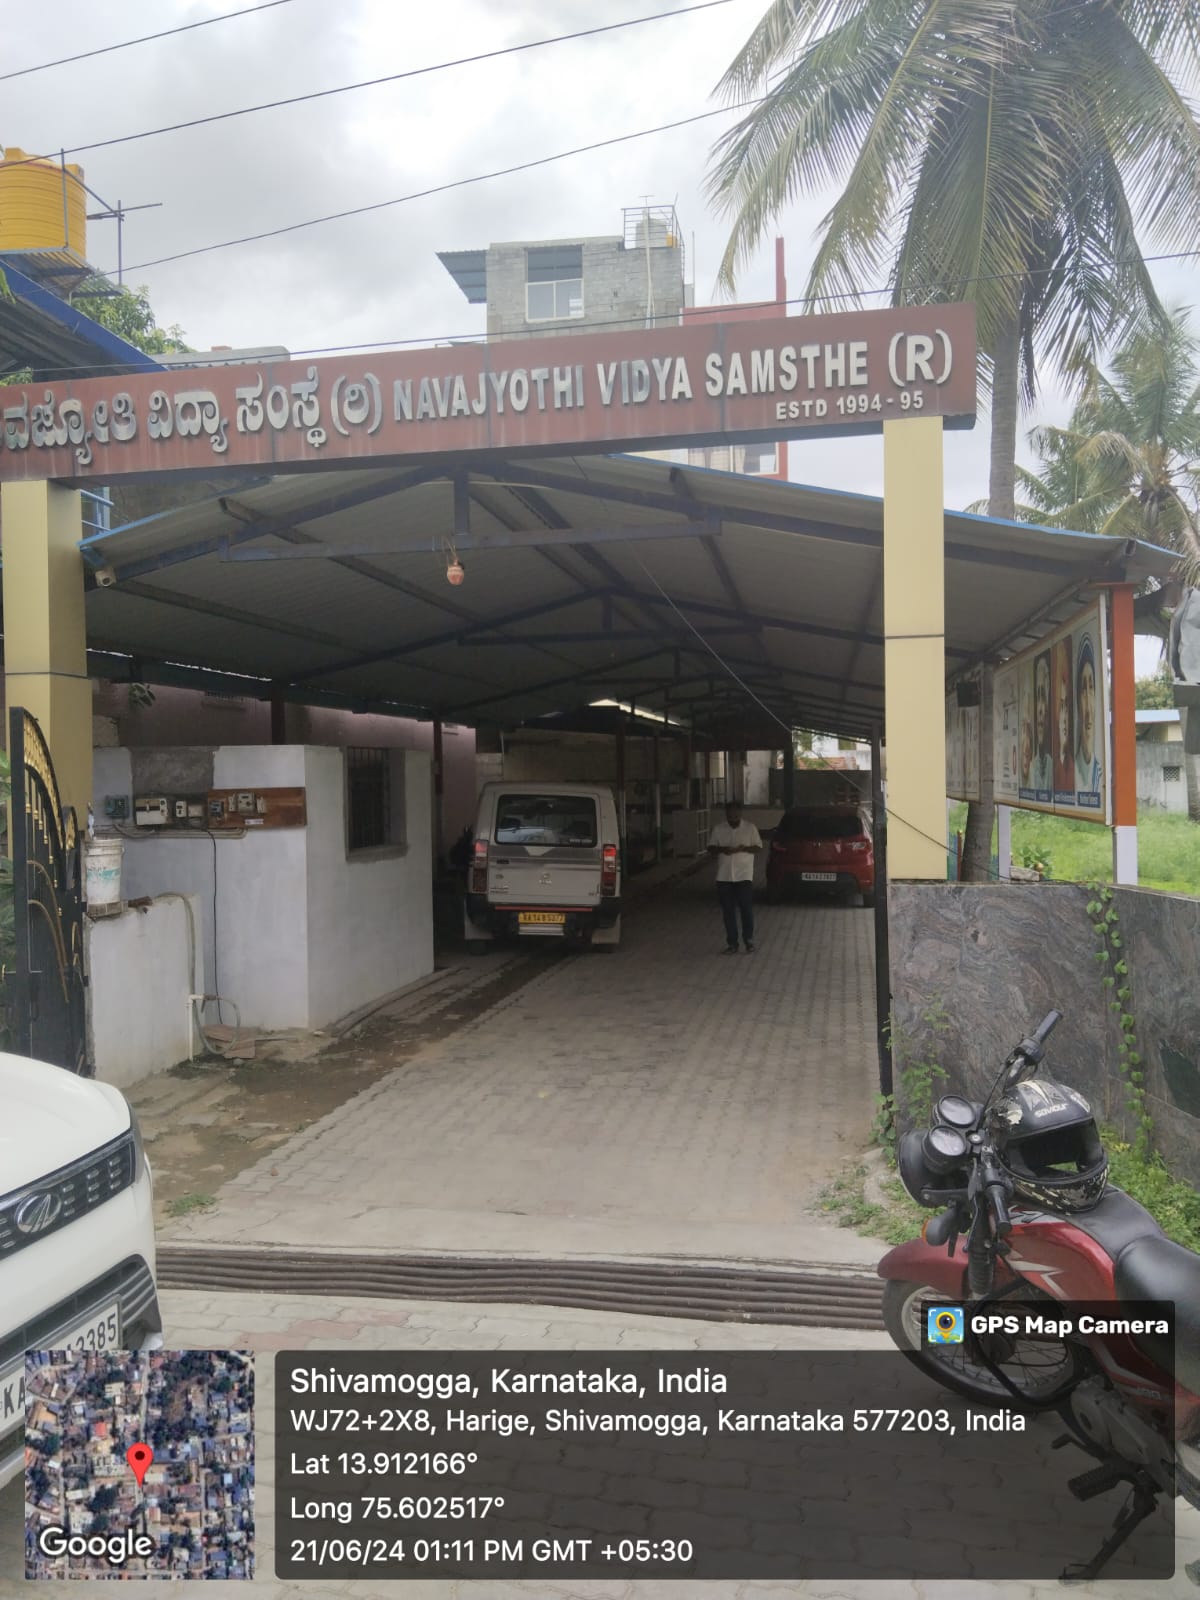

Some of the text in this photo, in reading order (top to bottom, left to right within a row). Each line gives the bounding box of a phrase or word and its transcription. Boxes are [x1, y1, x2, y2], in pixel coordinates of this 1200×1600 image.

[0, 365, 383, 466] ವಜ್ಯೋತಿ ವಿದ್ಯಾ ಸಂಸ್ಥೆ (ರಿ)
[393, 328, 953, 422] NAVAJYOTHI VIDYA SAMSTHE (R)
[776, 398, 828, 421] ESTD
